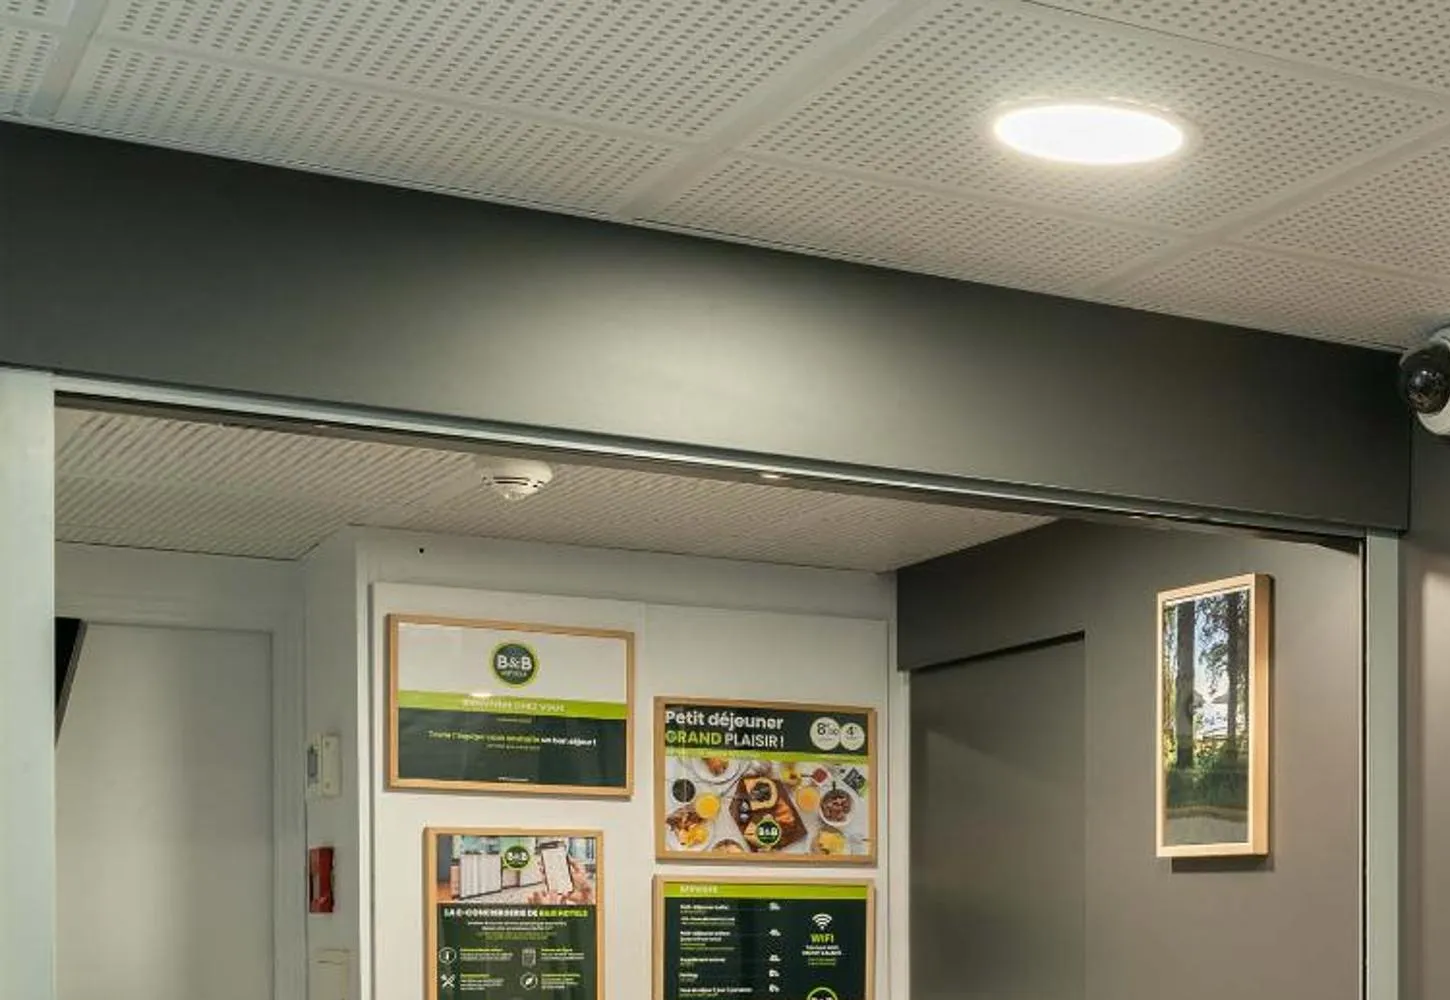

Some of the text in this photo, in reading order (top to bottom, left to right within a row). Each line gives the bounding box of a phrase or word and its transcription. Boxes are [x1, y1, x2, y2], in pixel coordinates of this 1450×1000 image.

[496, 655, 532, 670] B&B
[665, 711, 784, 731] Petit déjeuner
[665, 730, 722, 745] GRAND
[724, 733, 778, 748] PLAISIR
